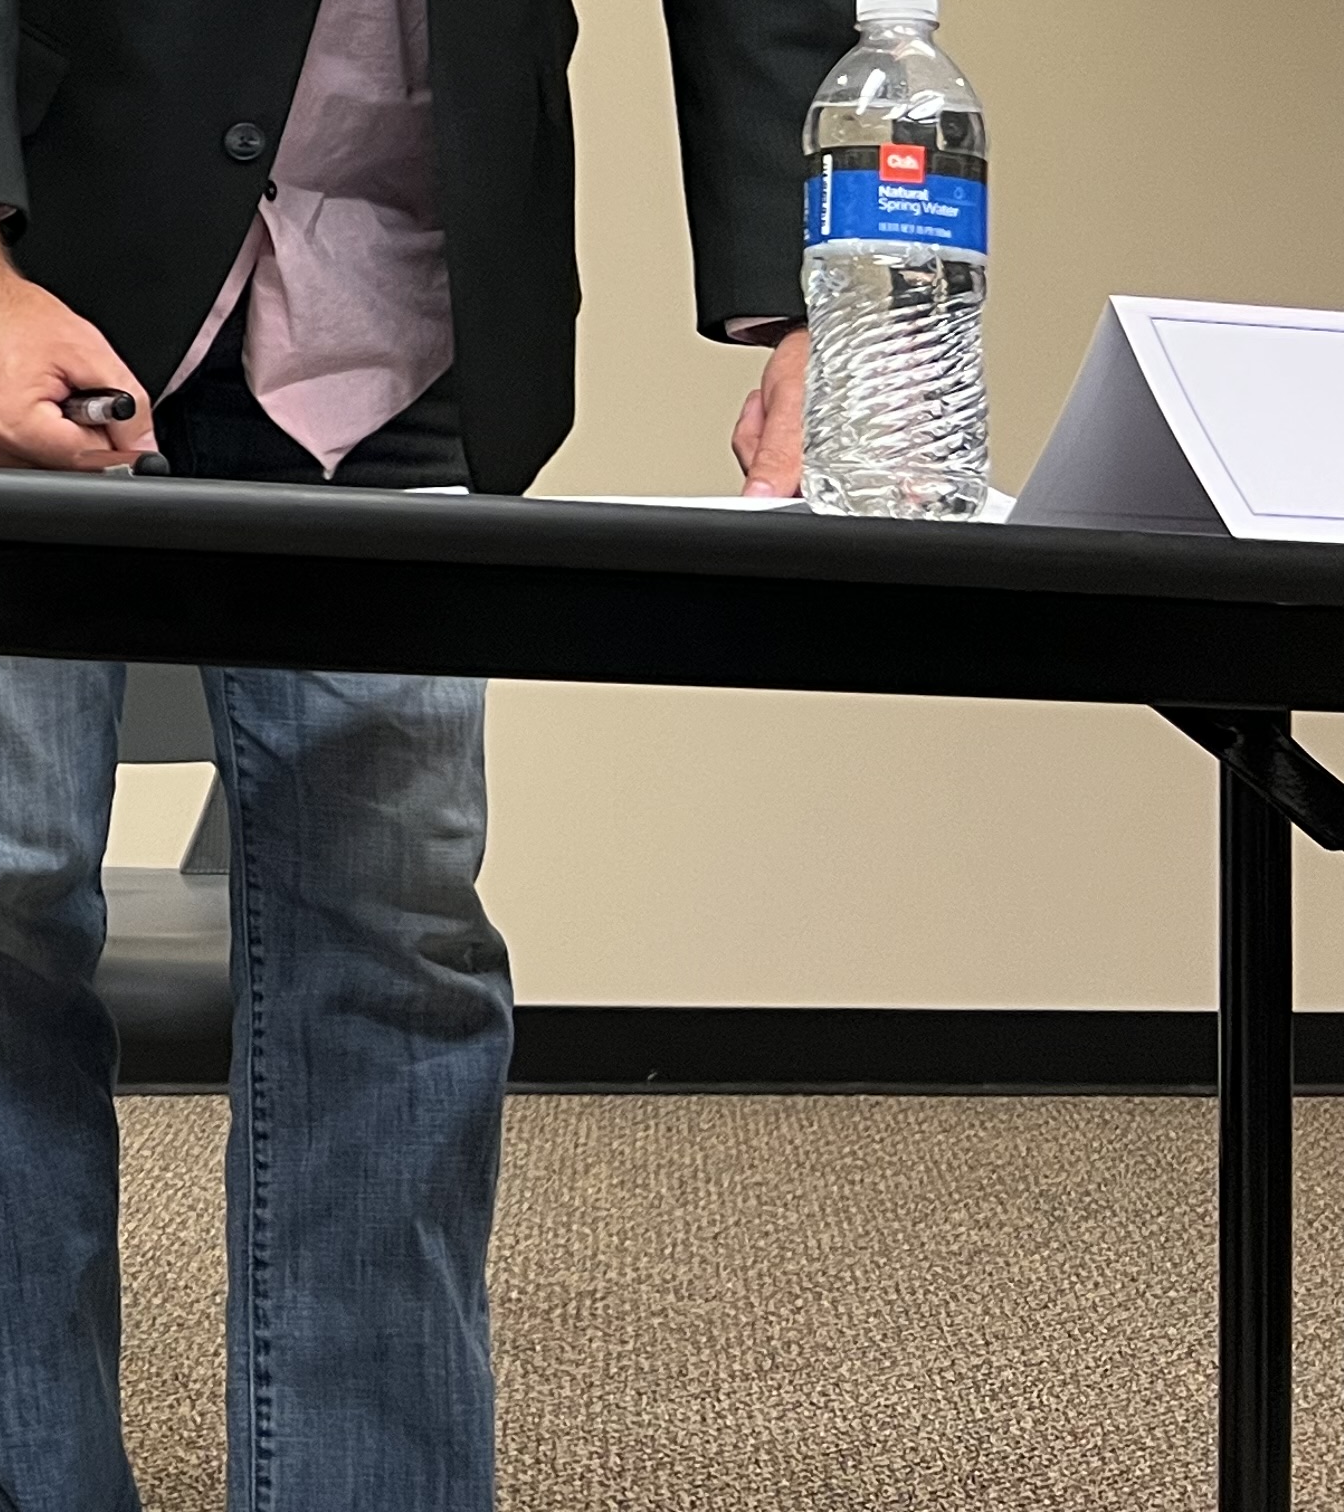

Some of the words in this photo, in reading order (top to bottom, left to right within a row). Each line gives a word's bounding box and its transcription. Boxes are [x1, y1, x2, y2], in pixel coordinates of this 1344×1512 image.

[878, 185, 929, 201] Natural
[878, 197, 921, 216] Spring
[921, 201, 960, 218] Water
